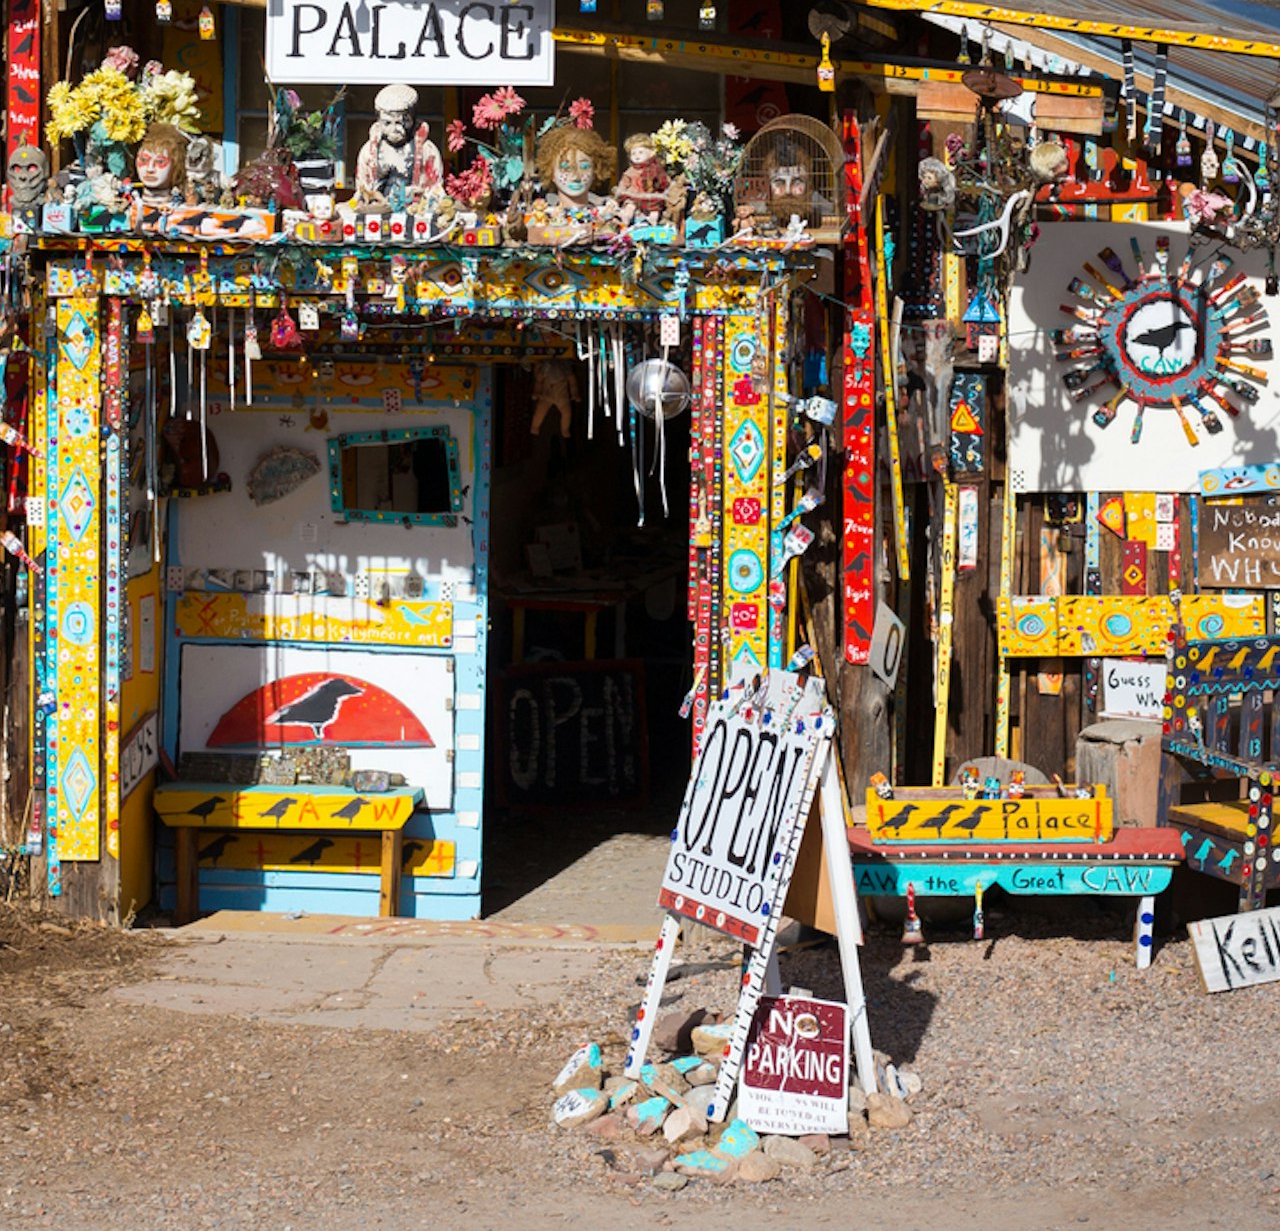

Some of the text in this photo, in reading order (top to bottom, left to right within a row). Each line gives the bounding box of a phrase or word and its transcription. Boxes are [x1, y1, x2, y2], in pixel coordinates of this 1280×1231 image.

[286, 1, 535, 61] PALACE
[1141, 355, 1183, 375] CAW
[1108, 668, 1151, 689] Guess
[509, 672, 636, 797] OPEN
[682, 719, 804, 882] OPEN
[1001, 801, 1091, 840] Palace
[668, 851, 764, 914] STUDIO
[925, 871, 959, 891] the
[1012, 867, 1066, 890] Great
[1081, 866, 1154, 892] CAW
[770, 1010, 821, 1039] NO
[748, 1042, 843, 1085] PARKING
